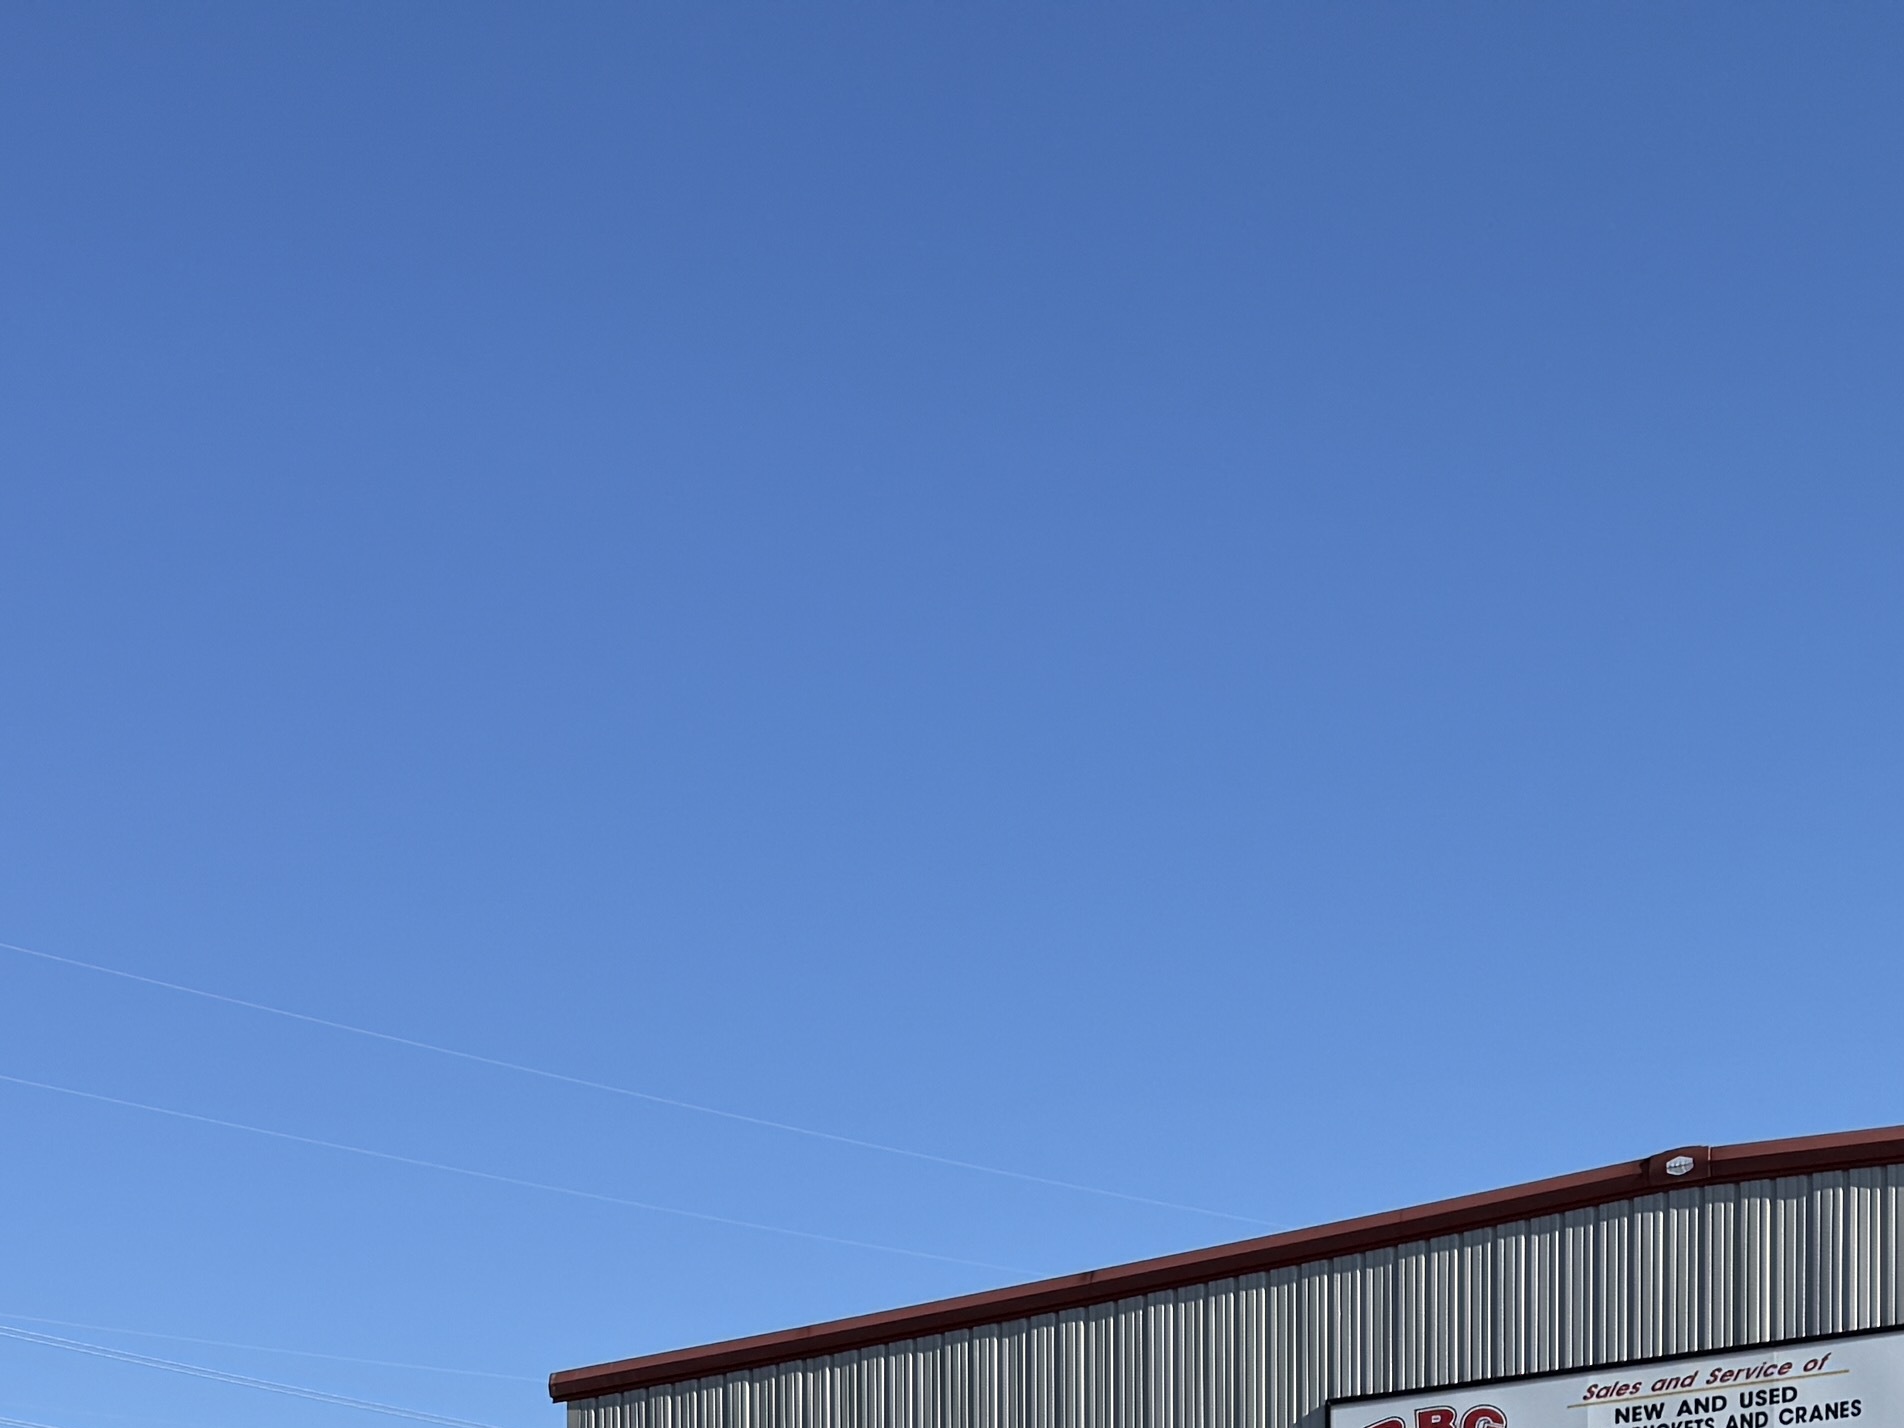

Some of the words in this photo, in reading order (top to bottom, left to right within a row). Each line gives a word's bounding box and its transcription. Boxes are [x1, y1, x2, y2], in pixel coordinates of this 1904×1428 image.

[1582, 1381, 1643, 1401] Sales
[1651, 1370, 1699, 1392] and
[1705, 1361, 1793, 1385] Service
[1802, 1352, 1832, 1373] of
[1615, 1402, 1665, 1424] NEW
[1676, 1395, 1727, 1417] AND
[1739, 1386, 1798, 1409] USED
[1778, 1399, 1862, 1426] CRANES
